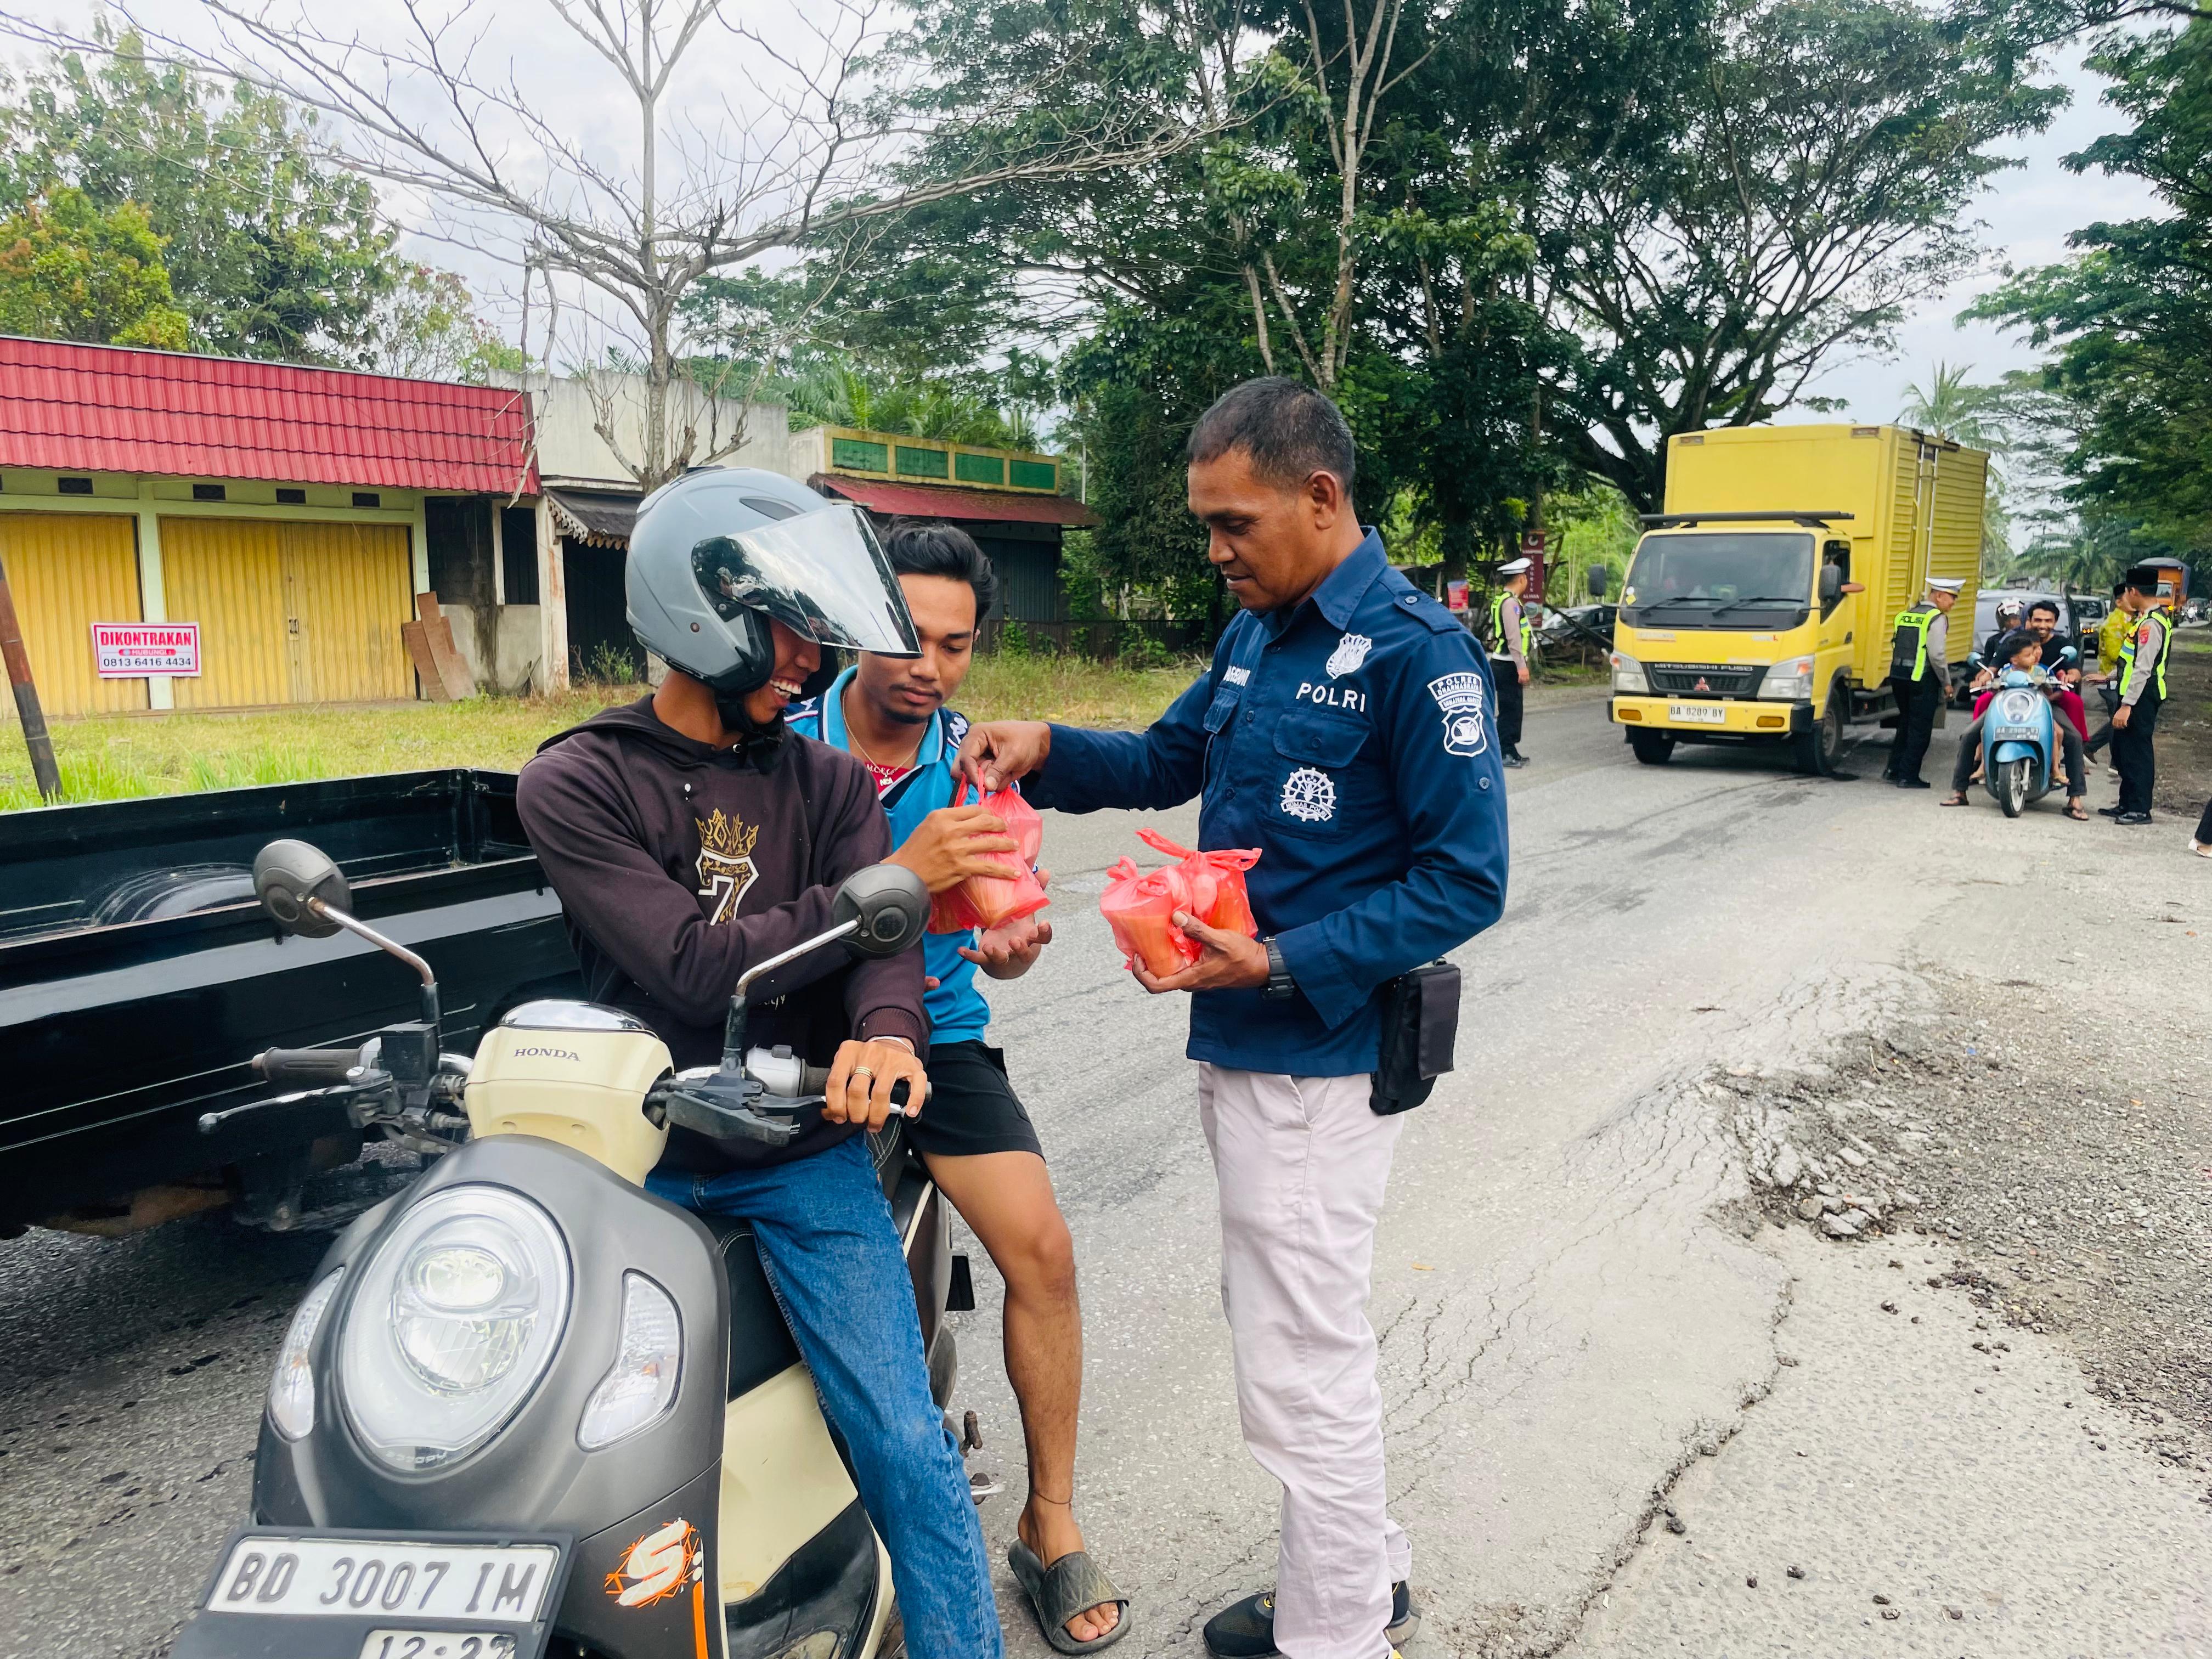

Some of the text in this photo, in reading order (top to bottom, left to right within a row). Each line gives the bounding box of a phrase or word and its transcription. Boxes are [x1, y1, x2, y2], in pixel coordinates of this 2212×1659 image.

[100, 631, 191, 646] DIKONTRAKAN
[103, 658, 131, 667] 0813
[1295, 682, 1365, 713] POLRI
[514, 1048, 581, 1062] HONDA
[227, 1553, 537, 1613] BD 3007 IM
